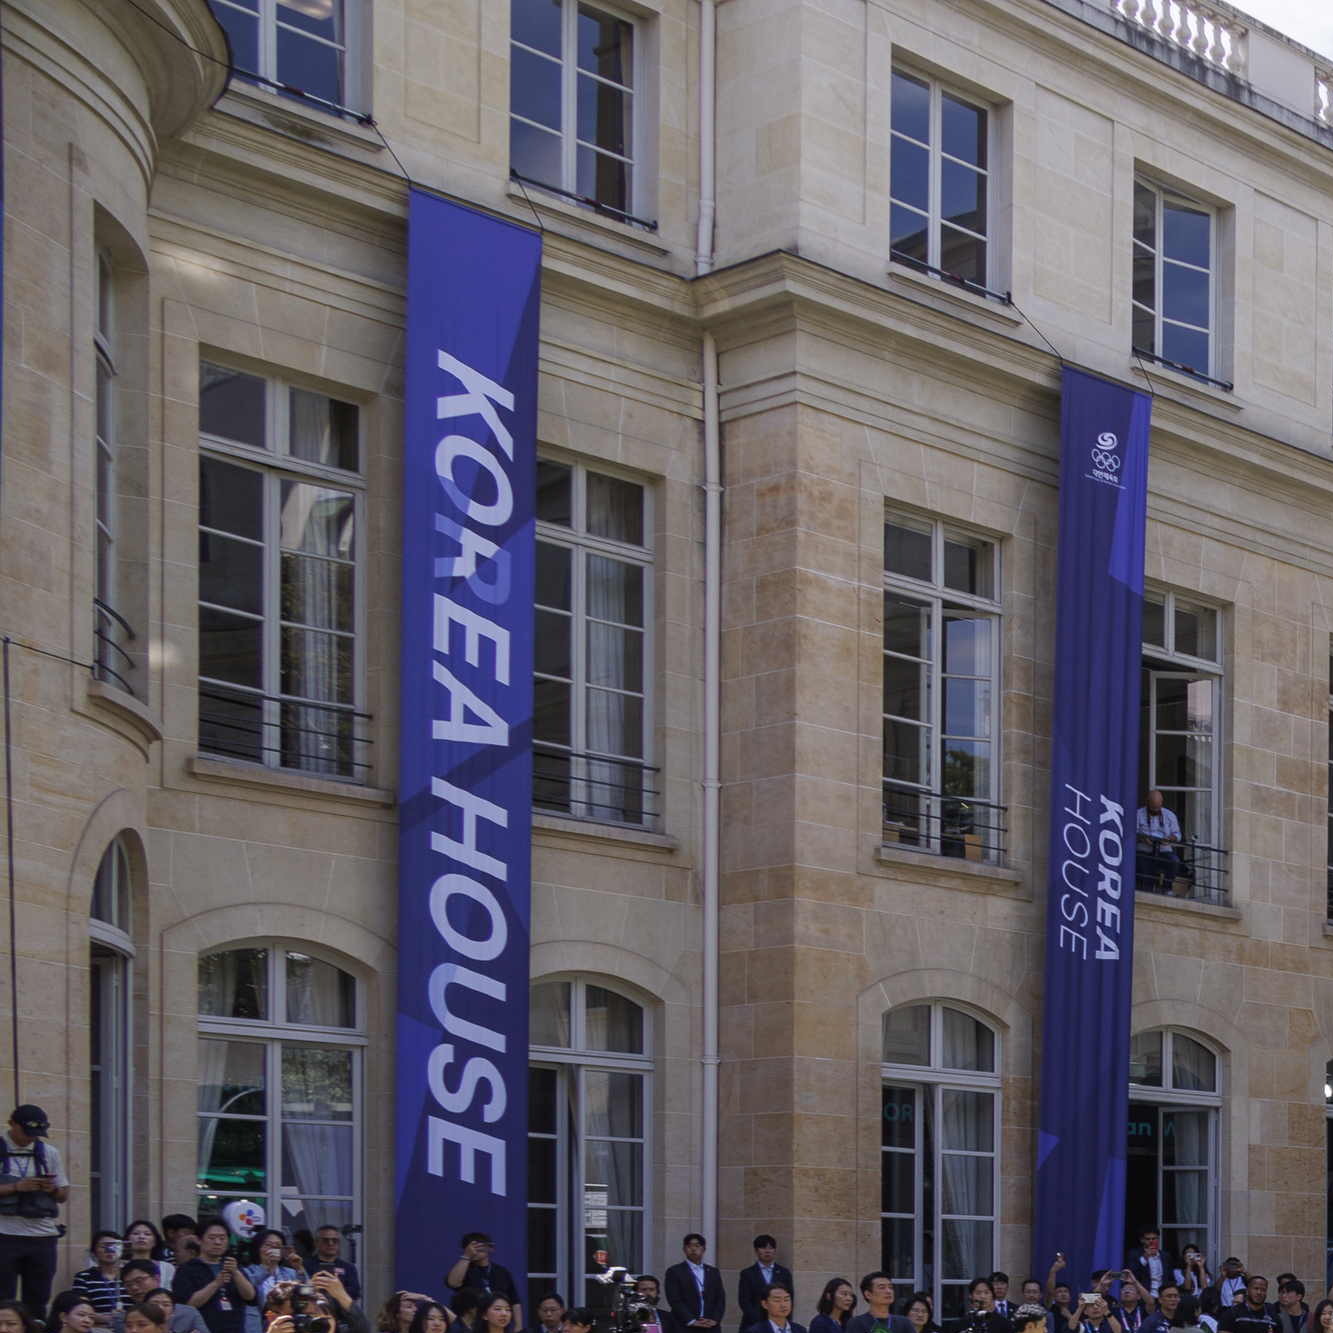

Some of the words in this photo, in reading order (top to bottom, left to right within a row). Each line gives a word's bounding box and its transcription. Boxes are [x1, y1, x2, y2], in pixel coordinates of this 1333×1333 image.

[432, 349, 515, 748] KOREA
[427, 776, 508, 1198] HOUSE
[1059, 783, 1094, 960] HOUSE
[1095, 793, 1125, 962] KOREA
